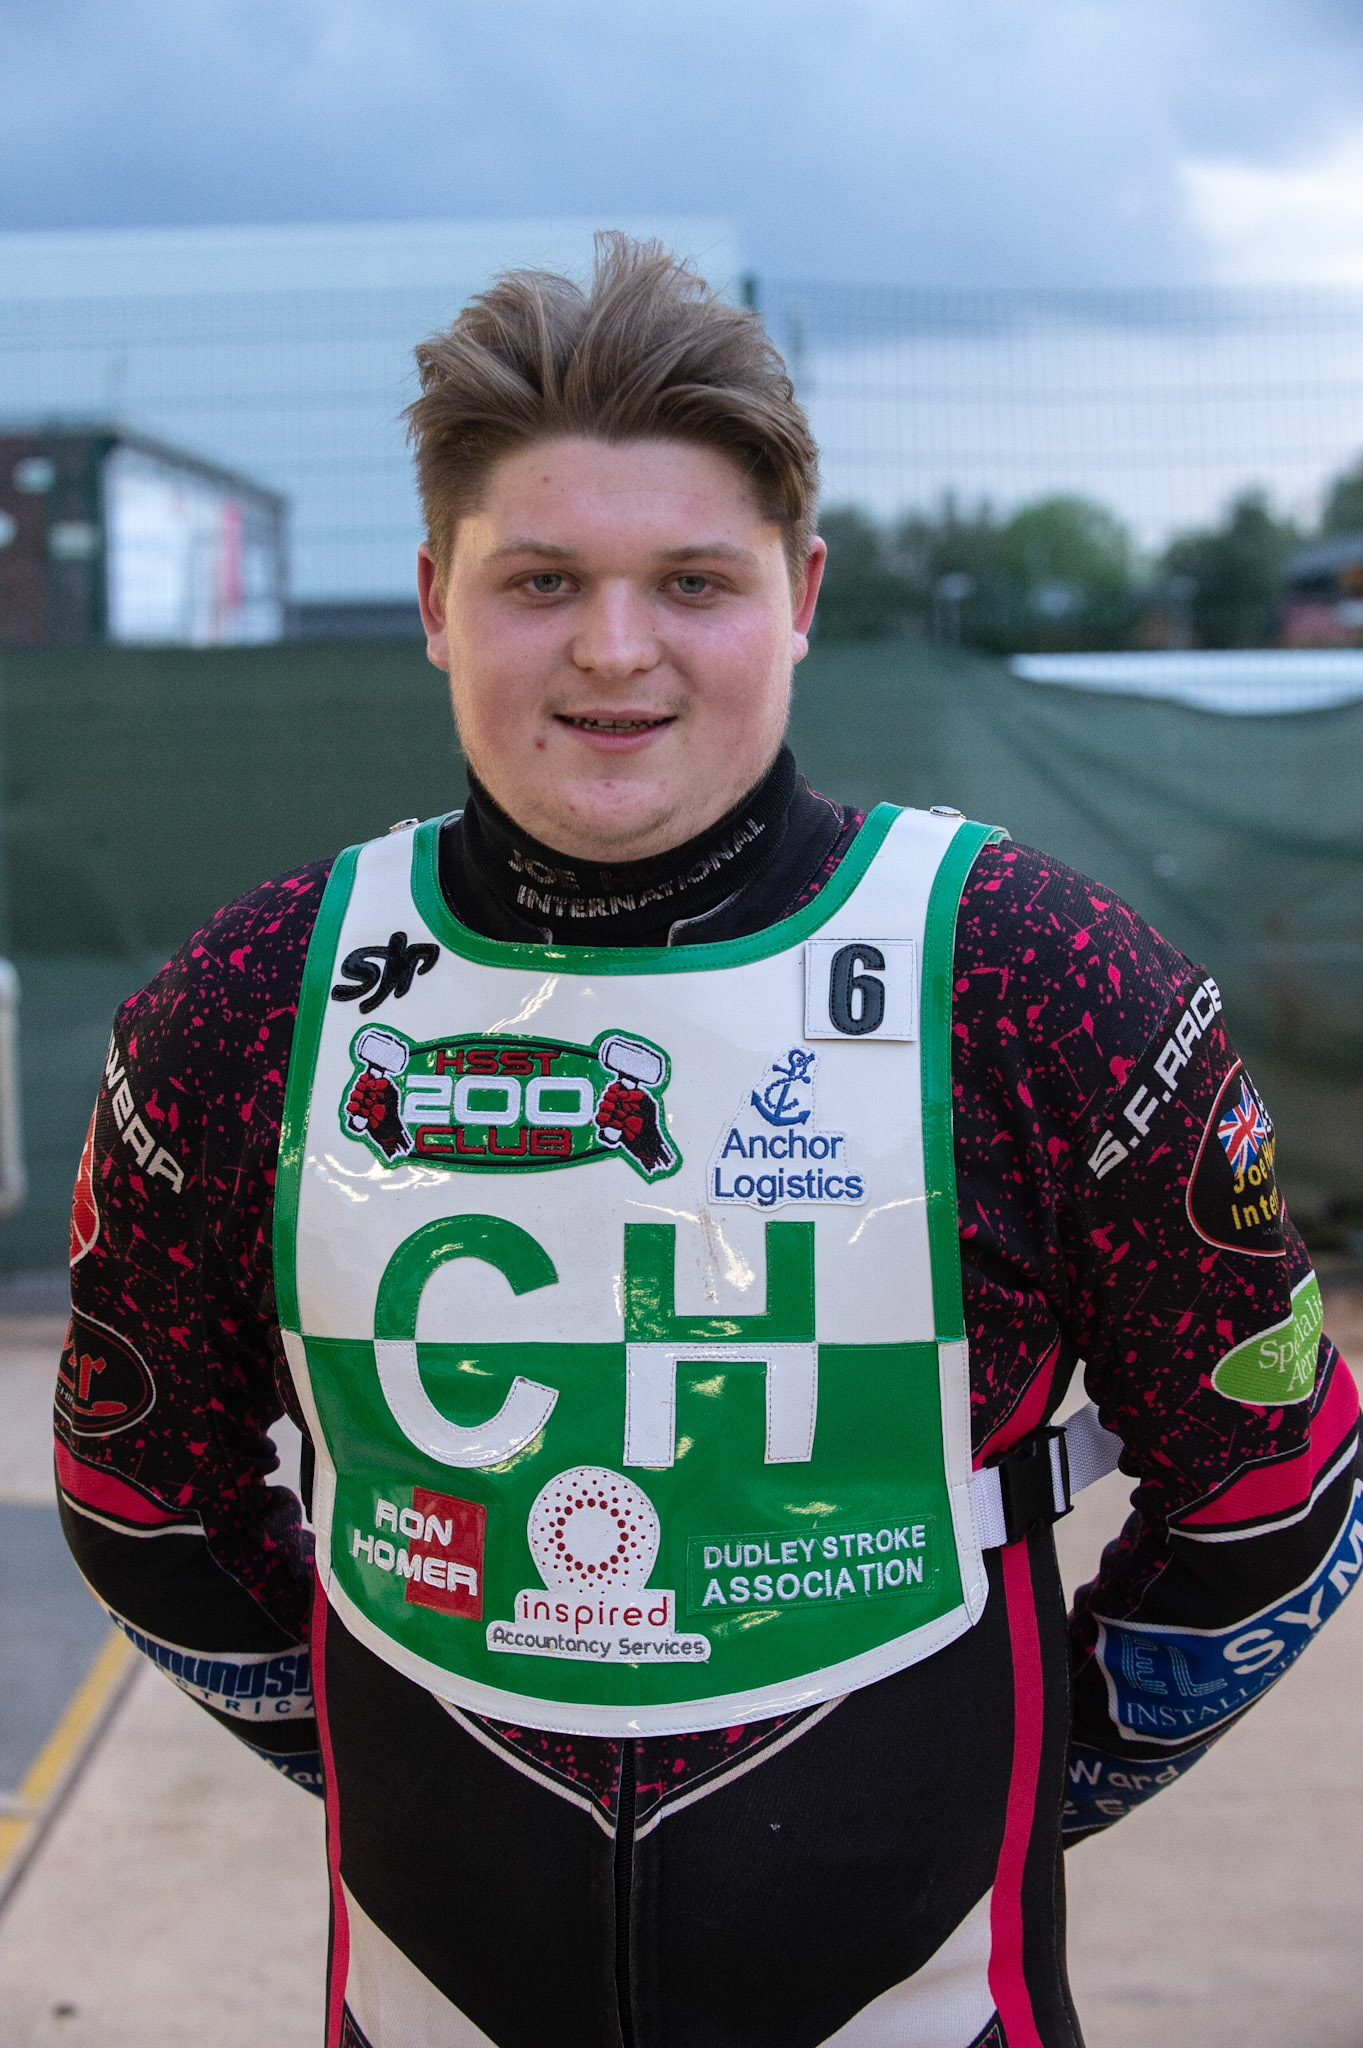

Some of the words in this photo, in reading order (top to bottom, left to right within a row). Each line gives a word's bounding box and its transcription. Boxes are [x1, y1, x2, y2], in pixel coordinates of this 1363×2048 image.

[508, 849, 580, 890] JOE
[516, 818, 765, 918] INTERNATIONAL
[829, 943, 886, 1036] 6
[435, 1050, 561, 1076] HSST
[105, 1029, 184, 1194] WEAR
[402, 1074, 594, 1126] 200
[415, 1126, 572, 1157] CLUB
[721, 1128, 844, 1160] Anchor
[714, 1167, 865, 1206] Logistics
[1233, 1157, 1268, 1194] Joe
[373, 1213, 818, 1469] CH
[375, 1498, 453, 1546] RON
[351, 1529, 477, 1596] HOMER
[703, 1538, 815, 1570] DUDLEY
[822, 1524, 926, 1560] STROKE
[701, 1556, 923, 1607] ASSOCIATION
[523, 1595, 668, 1634] inspired
[492, 1626, 612, 1658] Accountancy
[619, 1637, 705, 1656] Services
[1069, 1759, 1180, 1790] Ward
